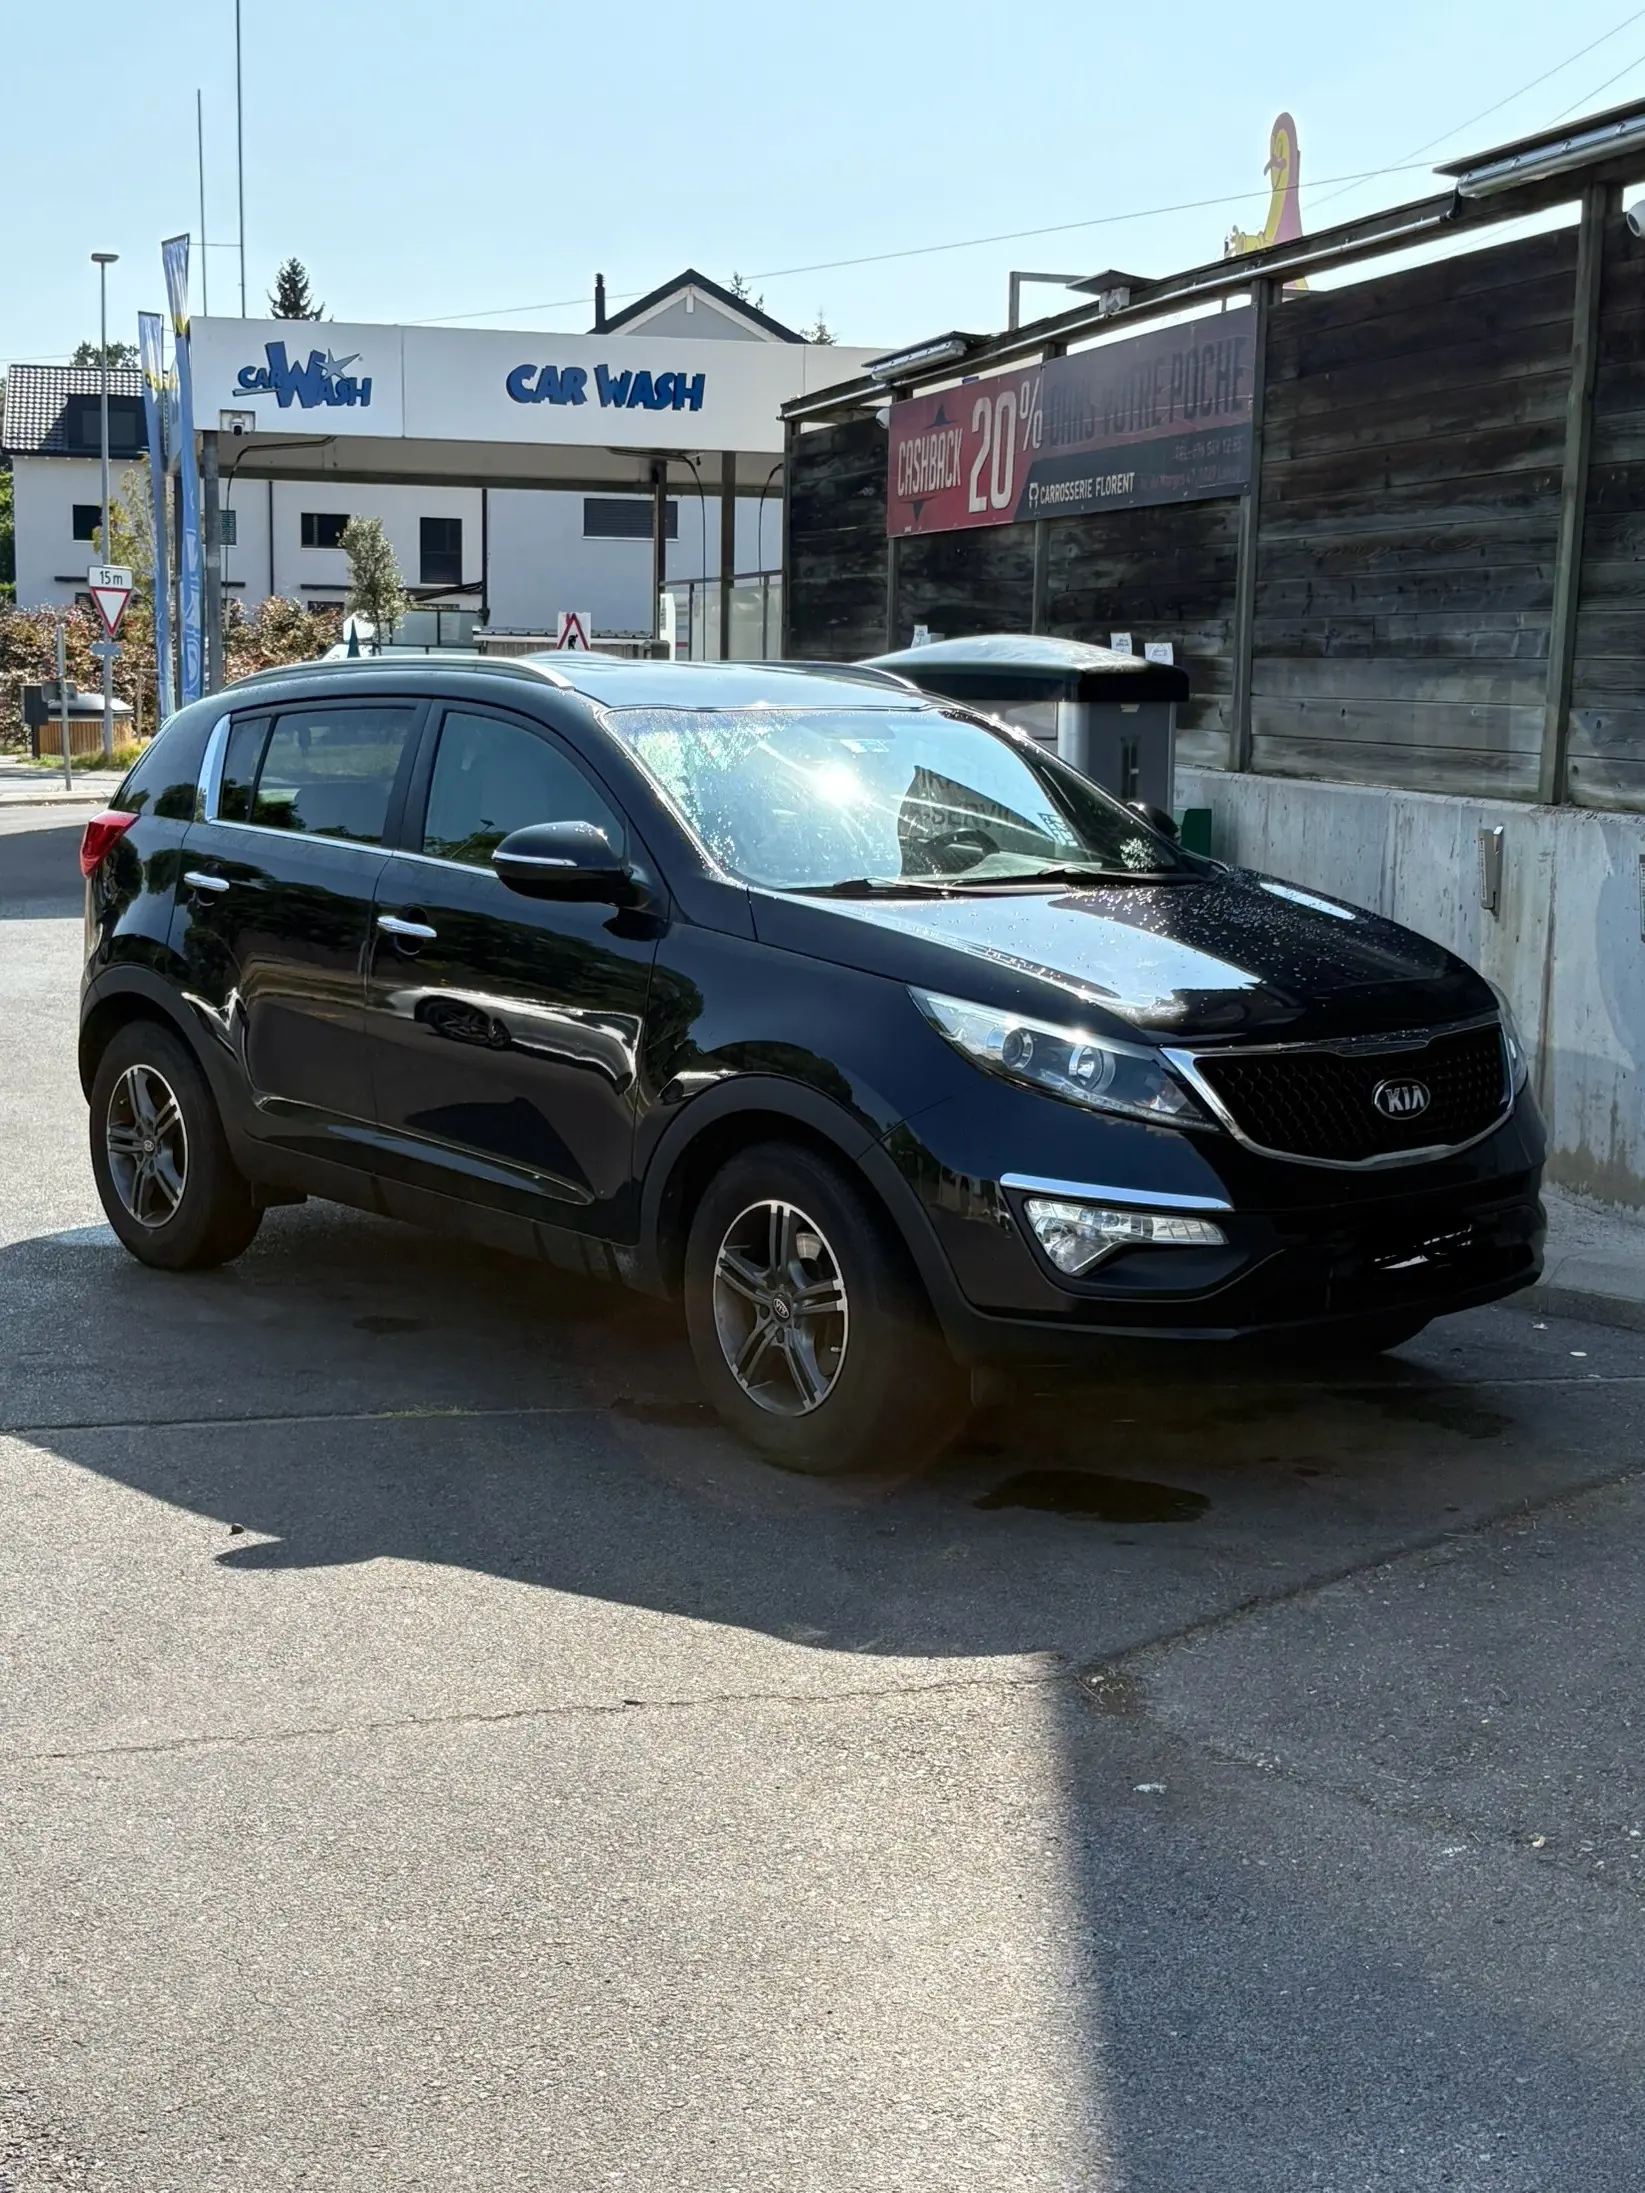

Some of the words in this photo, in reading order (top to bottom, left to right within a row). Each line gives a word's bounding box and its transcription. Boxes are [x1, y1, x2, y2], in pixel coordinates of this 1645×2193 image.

[506, 364, 588, 405] CAR
[594, 364, 706, 411] WASH
[898, 428, 963, 496] CASHBACK
[968, 377, 1043, 513] 20%
[1040, 479, 1093, 504] CARROSSERIE
[1095, 472, 1135, 497] FLORENT
[99, 570, 111, 585] 15
[113, 575, 123, 585] m
[1385, 1085, 1425, 1112] KIA
